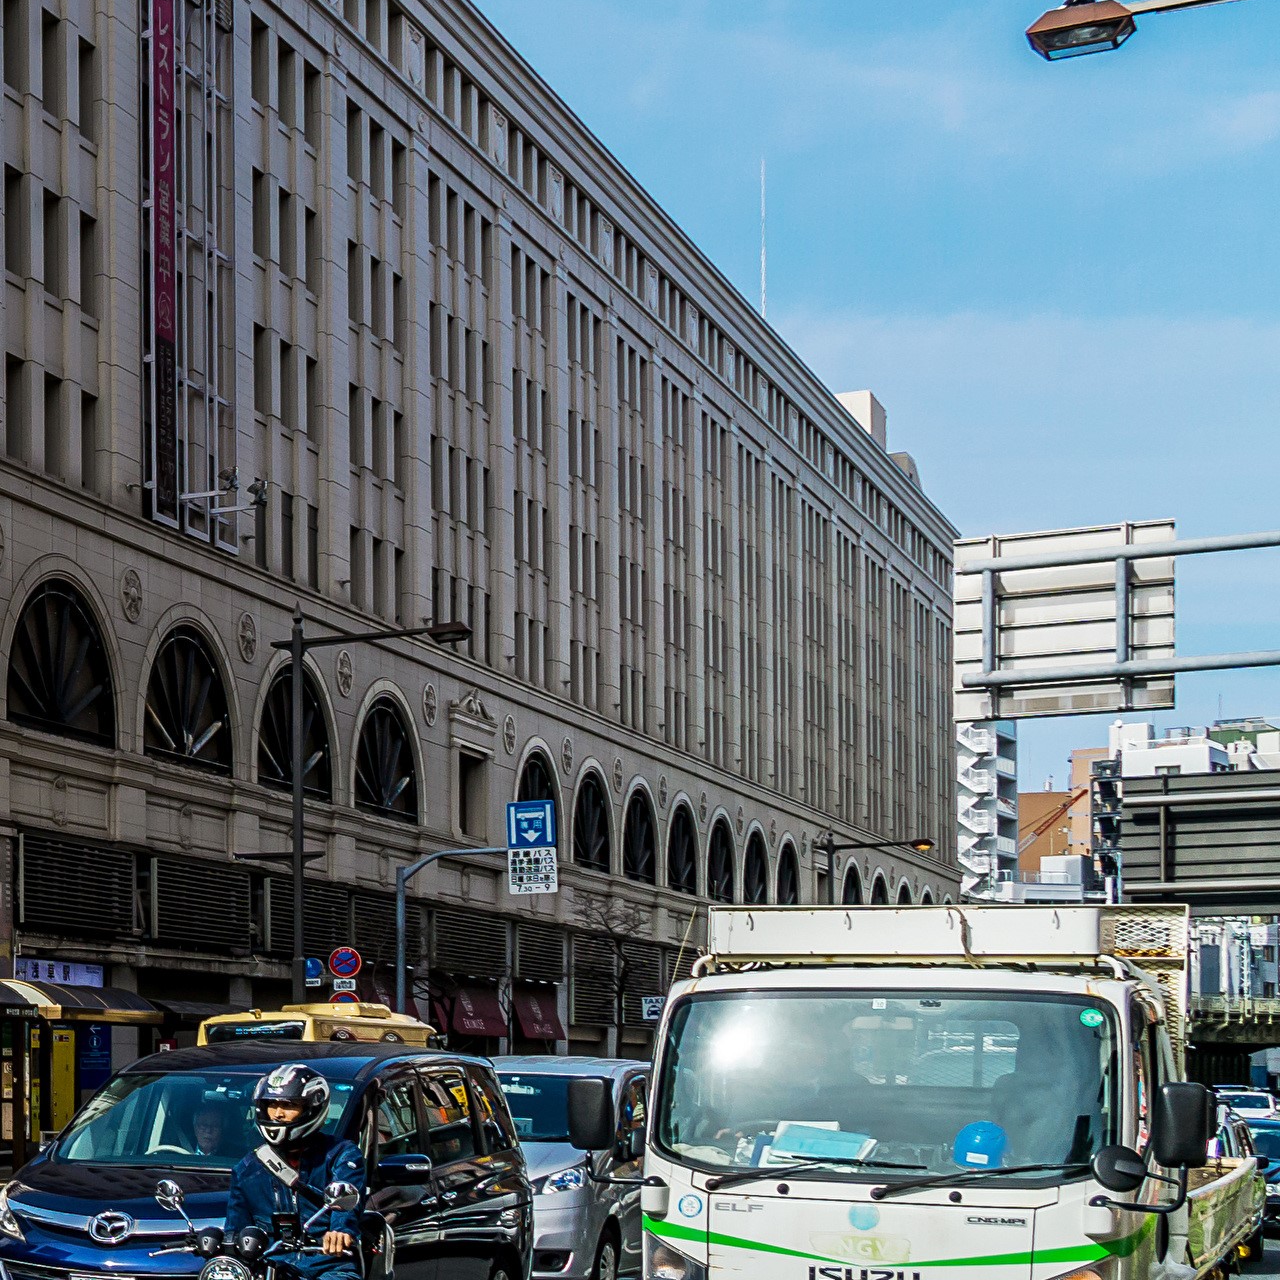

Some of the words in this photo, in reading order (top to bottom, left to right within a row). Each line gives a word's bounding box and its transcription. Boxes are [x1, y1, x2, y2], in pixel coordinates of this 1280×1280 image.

[157, 6, 171, 172] レストラン
[714, 1202, 764, 1213] ELF
[840, 1236, 891, 1258] NGV
